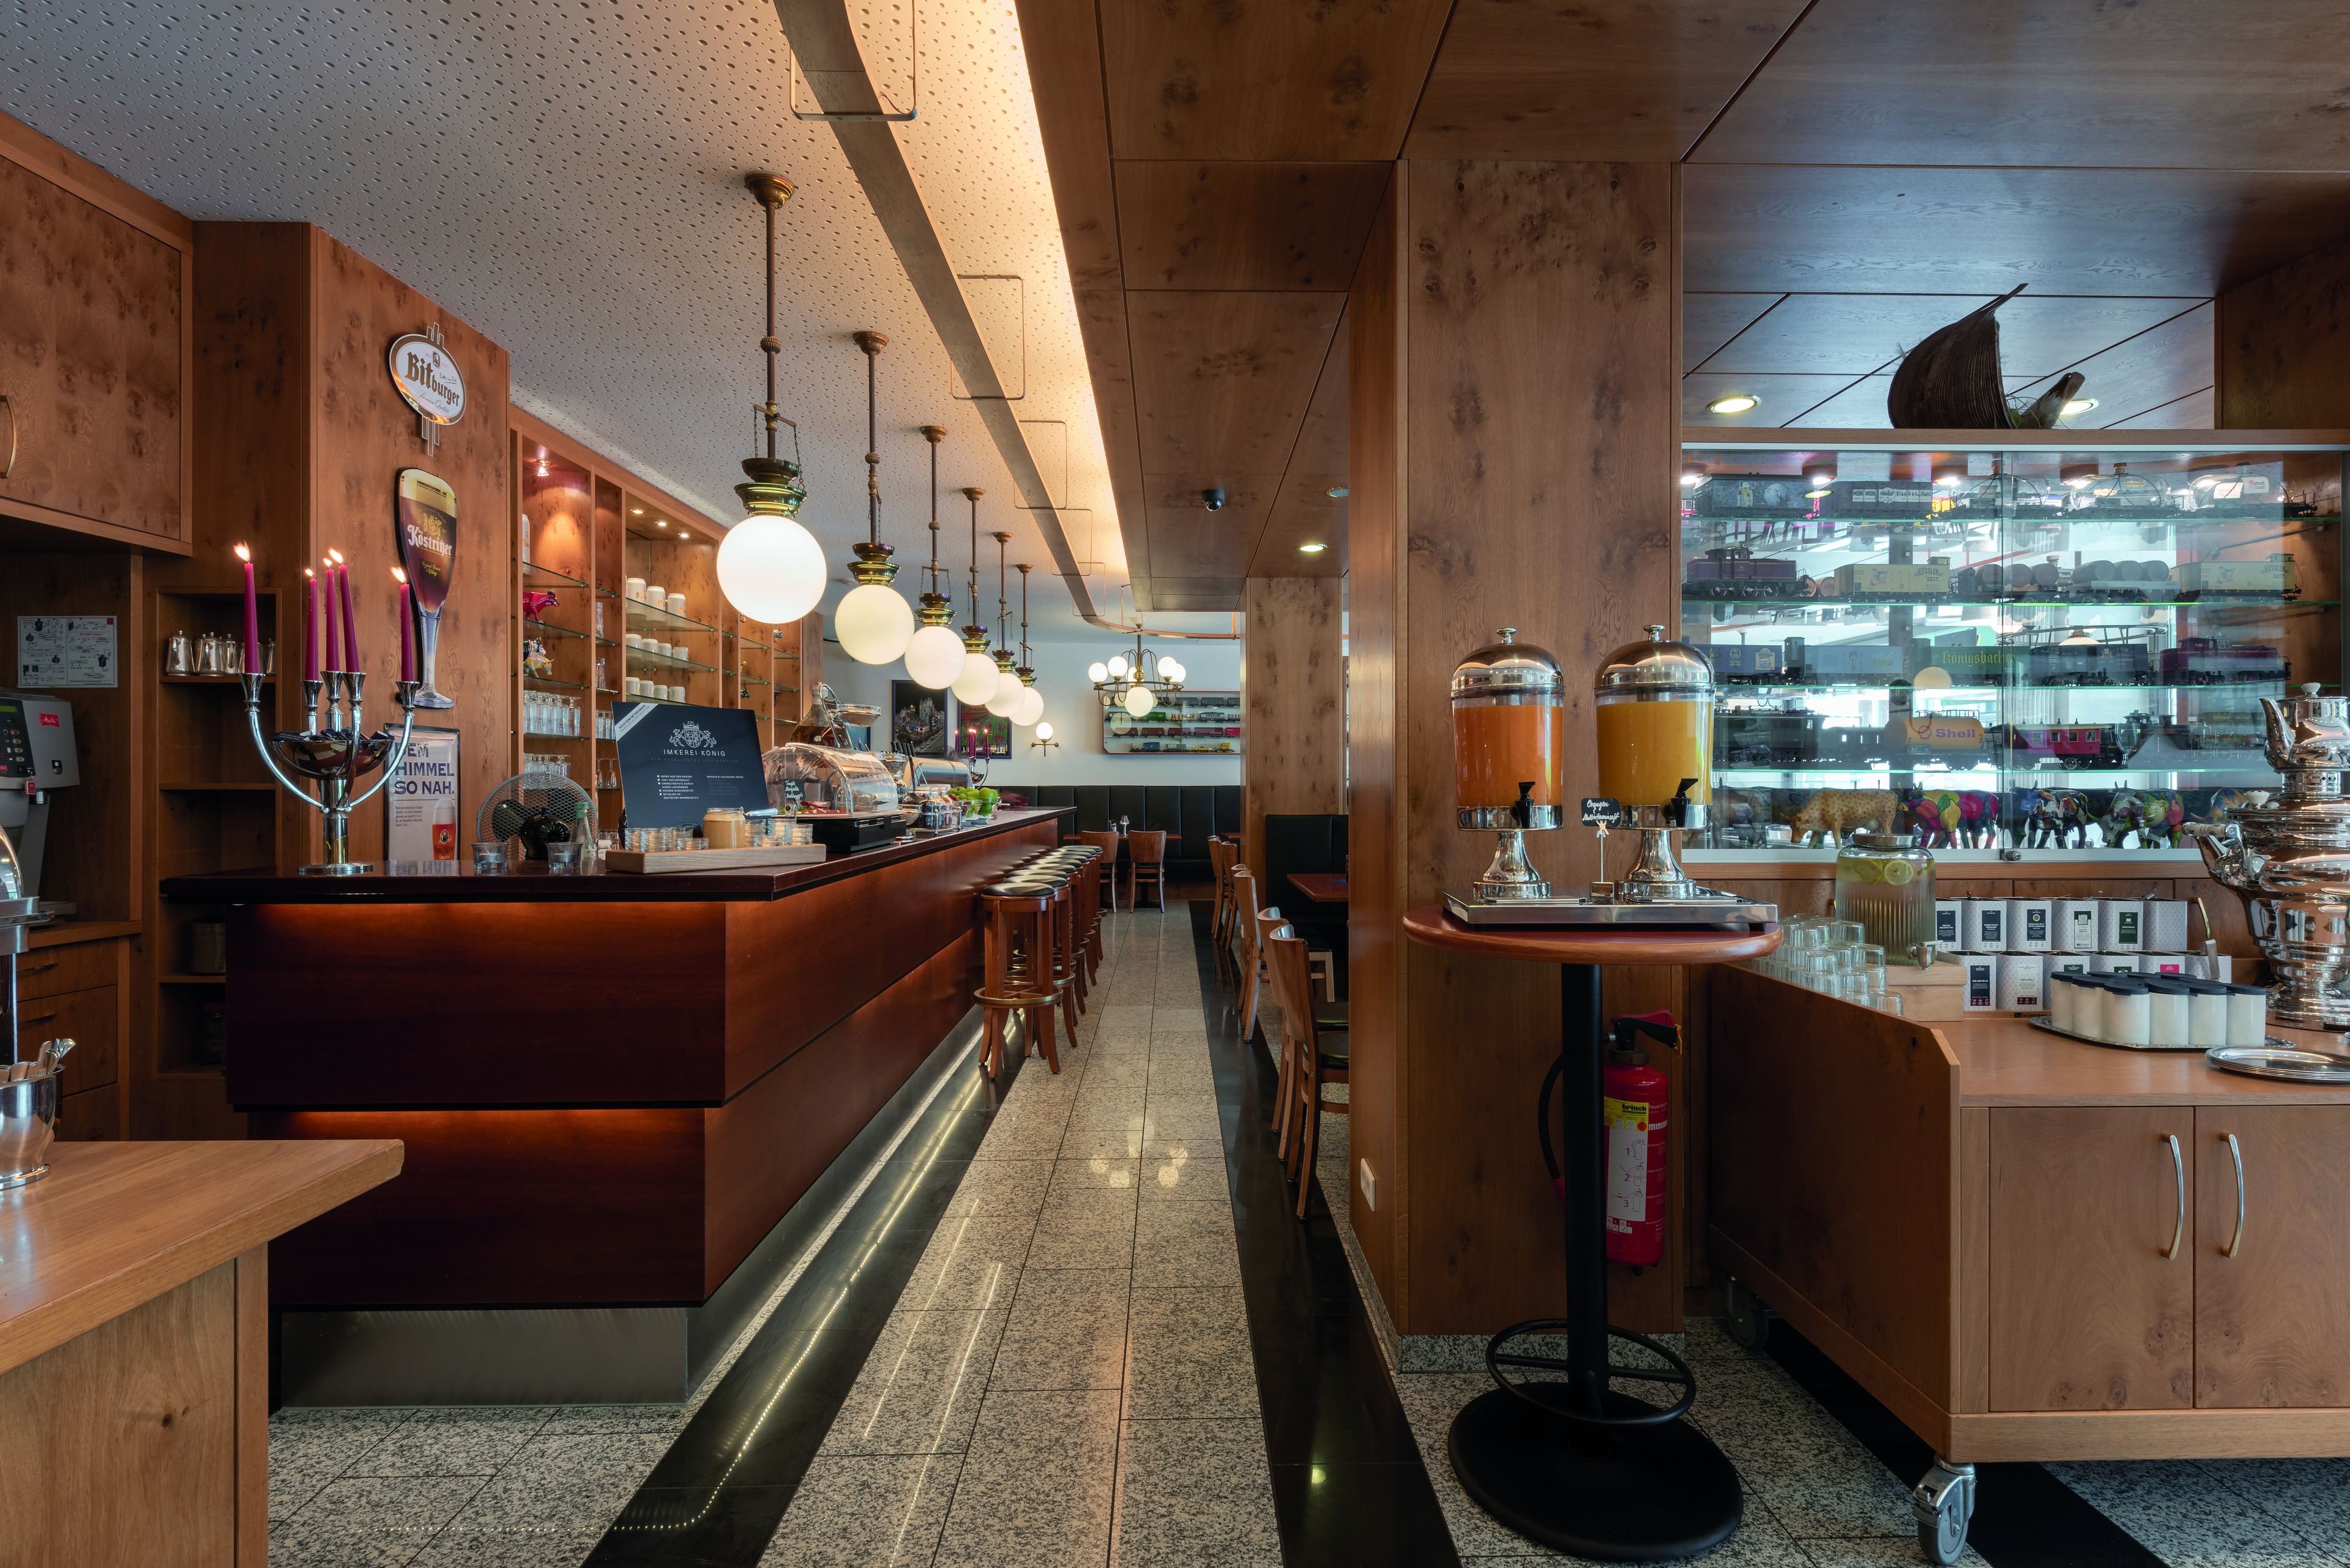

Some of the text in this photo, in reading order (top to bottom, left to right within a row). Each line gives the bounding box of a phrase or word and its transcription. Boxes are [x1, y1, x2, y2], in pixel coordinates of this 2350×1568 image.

[405, 351, 460, 406] Bitburger
[407, 524, 452, 556] Köstritzer
[1918, 567, 1939, 577] KESSLER
[2264, 565, 2285, 573] KESSLER
[1942, 649, 2016, 667] Königsbacher
[1936, 728, 1975, 738] Shell
[395, 761, 455, 777] HIMMEL
[394, 780, 455, 794] SO NAH.
[1587, 799, 1610, 811] Orangen
[1624, 1173, 1630, 1182] 2
